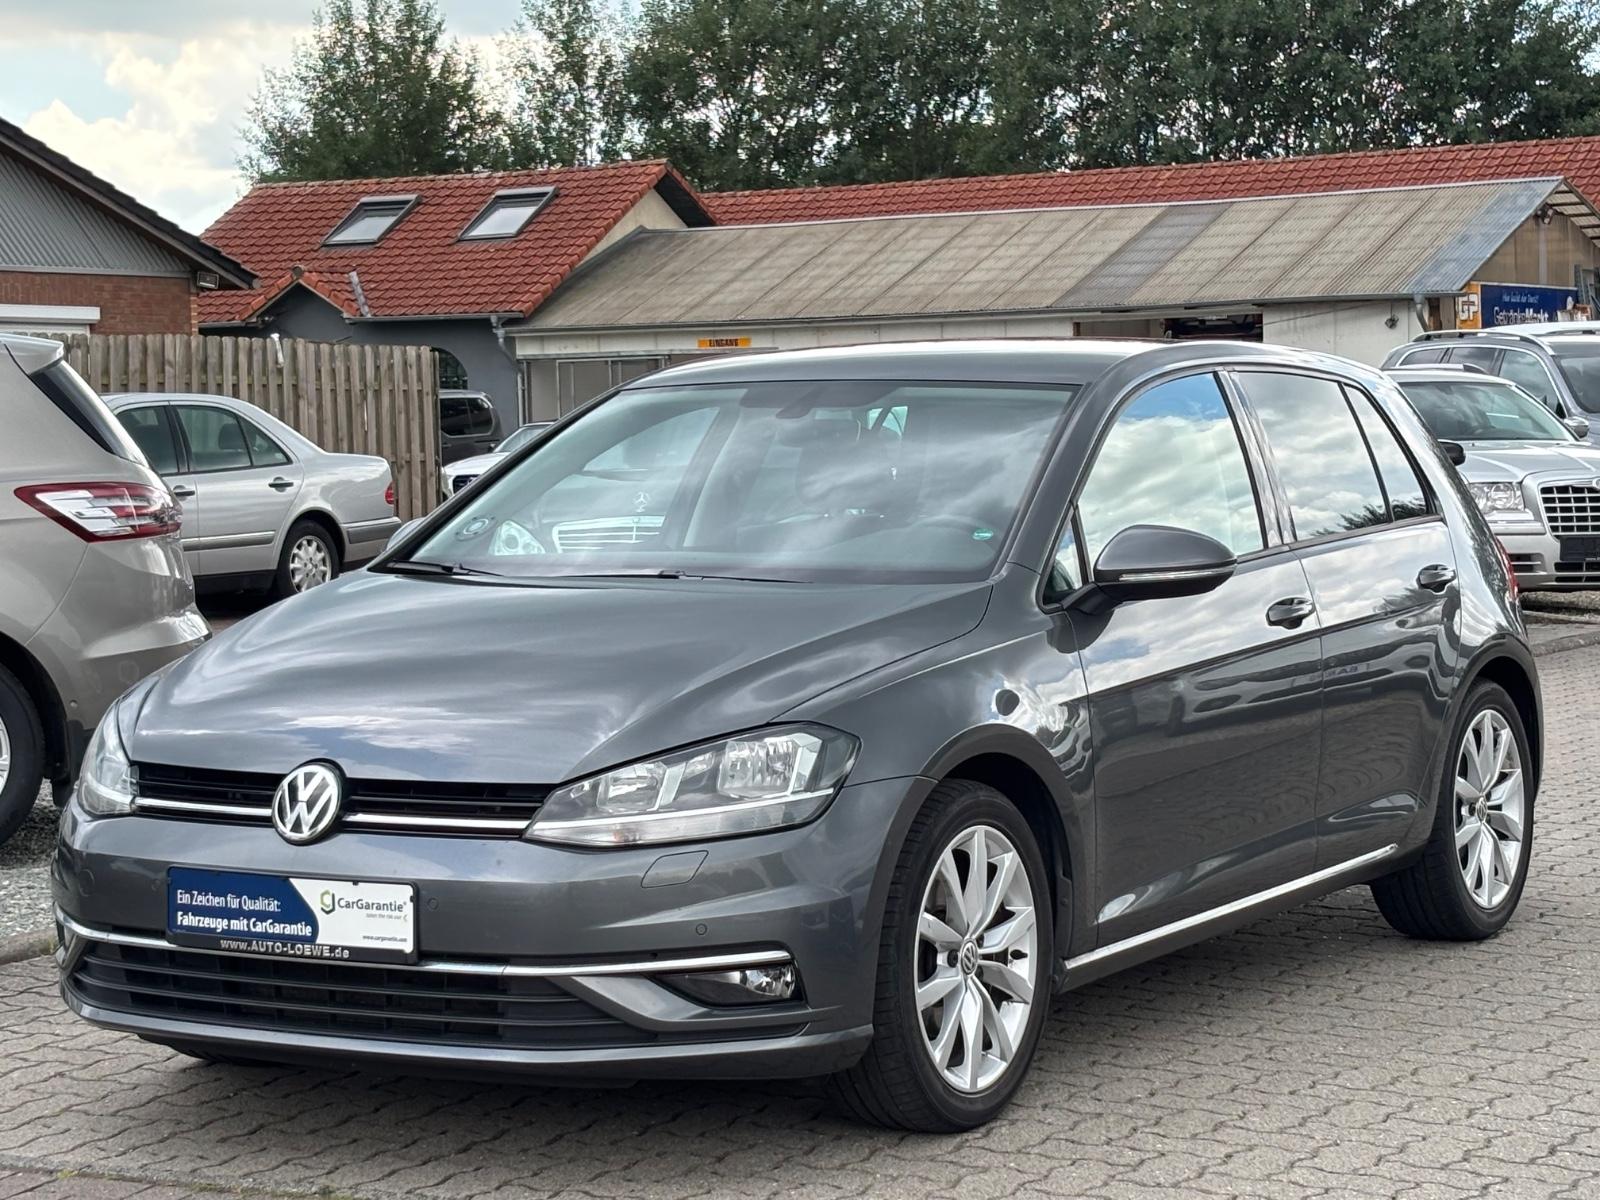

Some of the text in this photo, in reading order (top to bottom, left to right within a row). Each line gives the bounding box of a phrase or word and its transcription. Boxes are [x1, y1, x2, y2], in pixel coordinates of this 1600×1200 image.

[708, 338, 739, 347] EINGANG
[274, 765, 339, 840] VW
[177, 889, 190, 904] Ein
[192, 891, 226, 907] Zeichen
[227, 893, 240, 909] für
[177, 911, 313, 937] Fahrzeuge mit CarGarantie
[220, 939, 350, 958] www.AUTO-LOEWE.de
